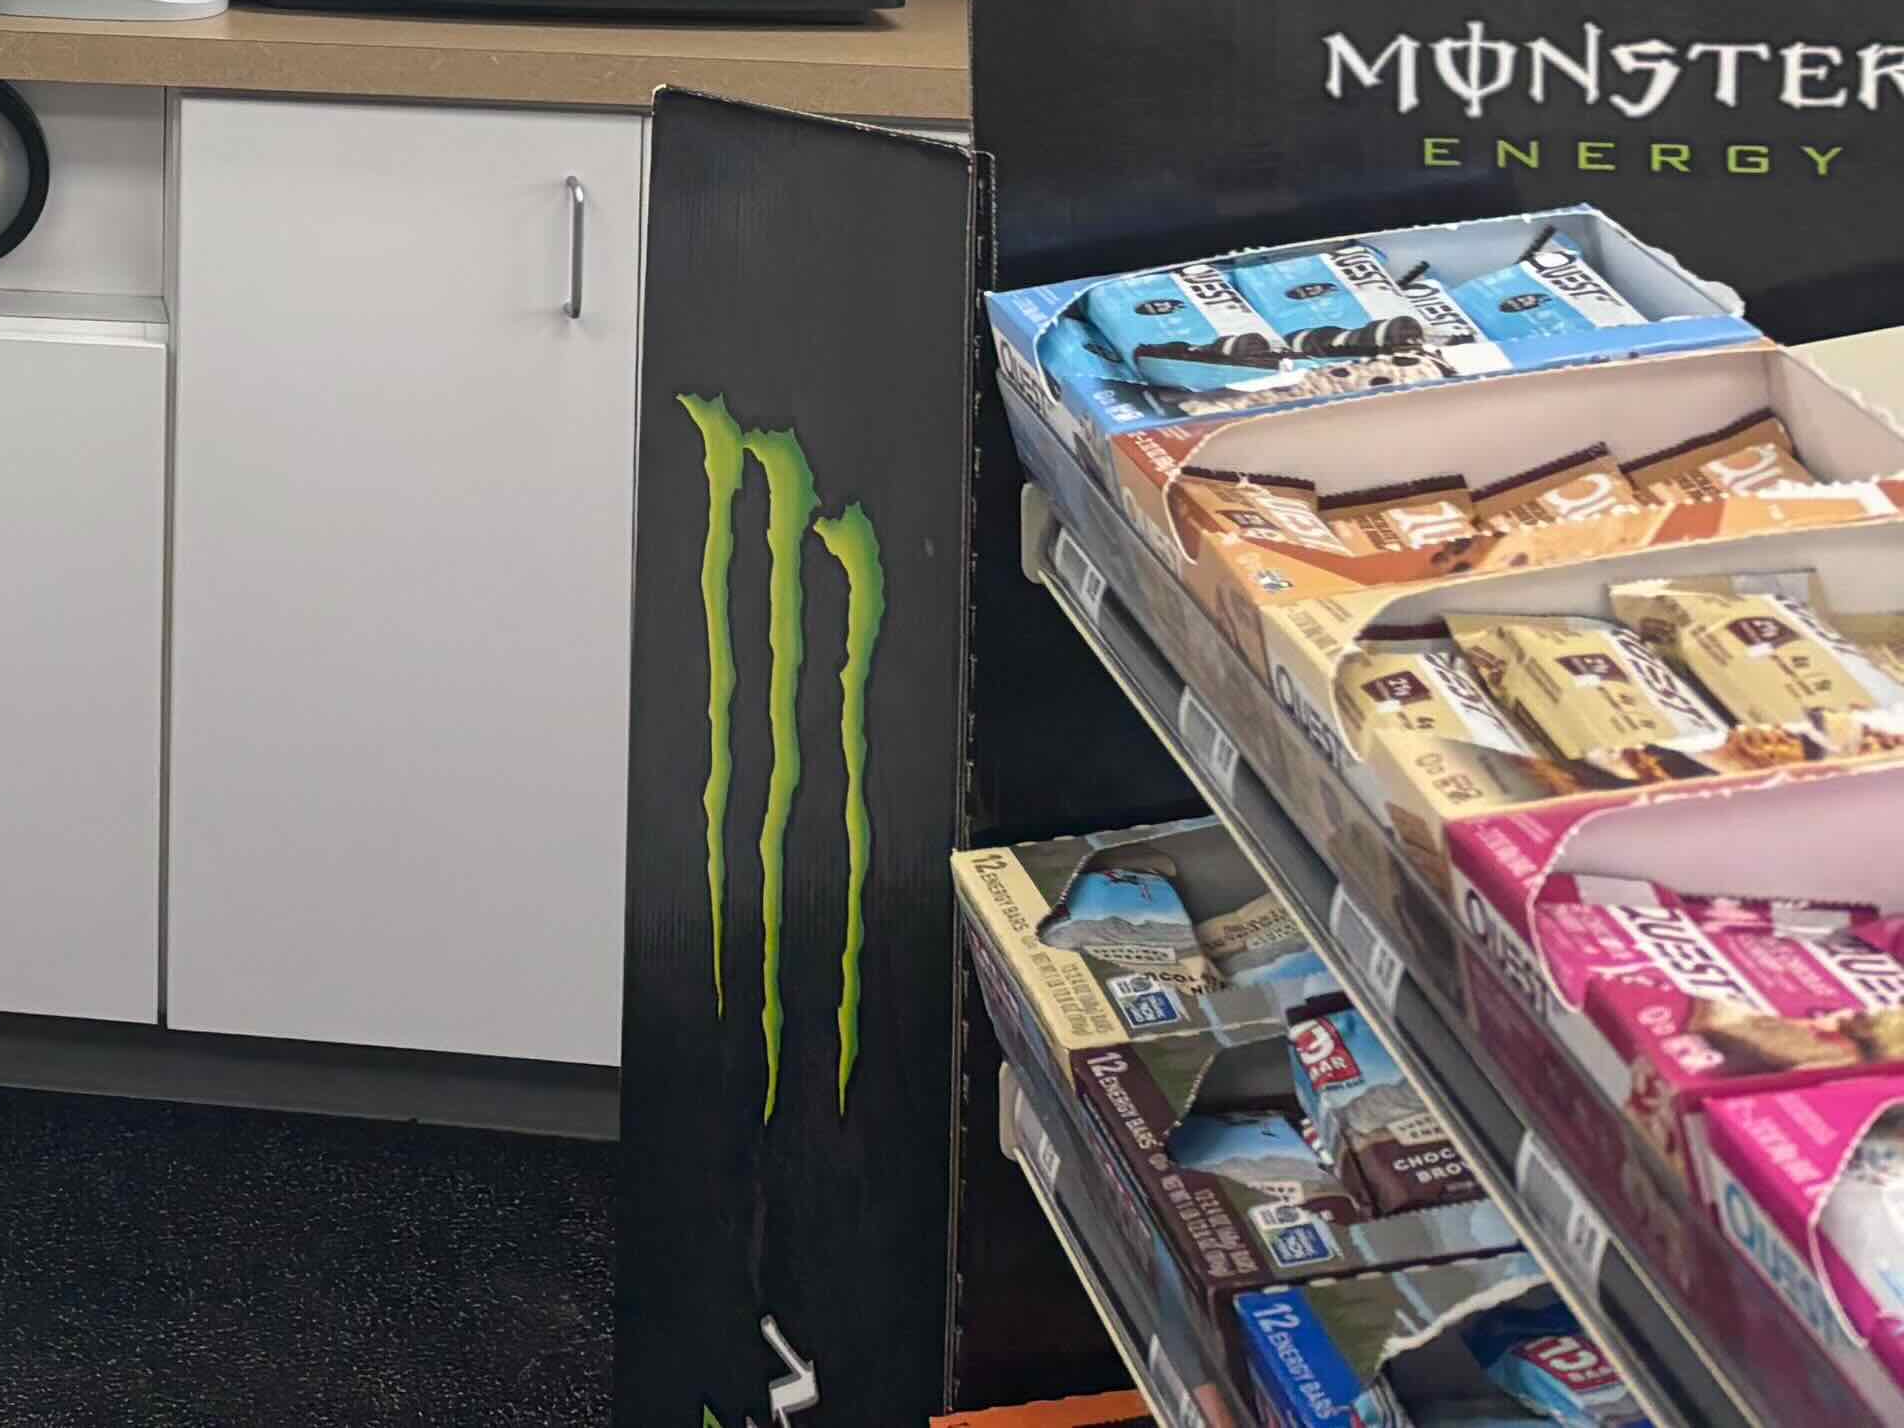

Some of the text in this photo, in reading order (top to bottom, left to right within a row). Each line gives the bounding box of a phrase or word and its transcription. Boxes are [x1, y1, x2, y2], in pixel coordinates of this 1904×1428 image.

[1423, 137, 1845, 177] ENERGY
[971, 854, 1009, 875] 12
[1087, 1051, 1129, 1077] 12
